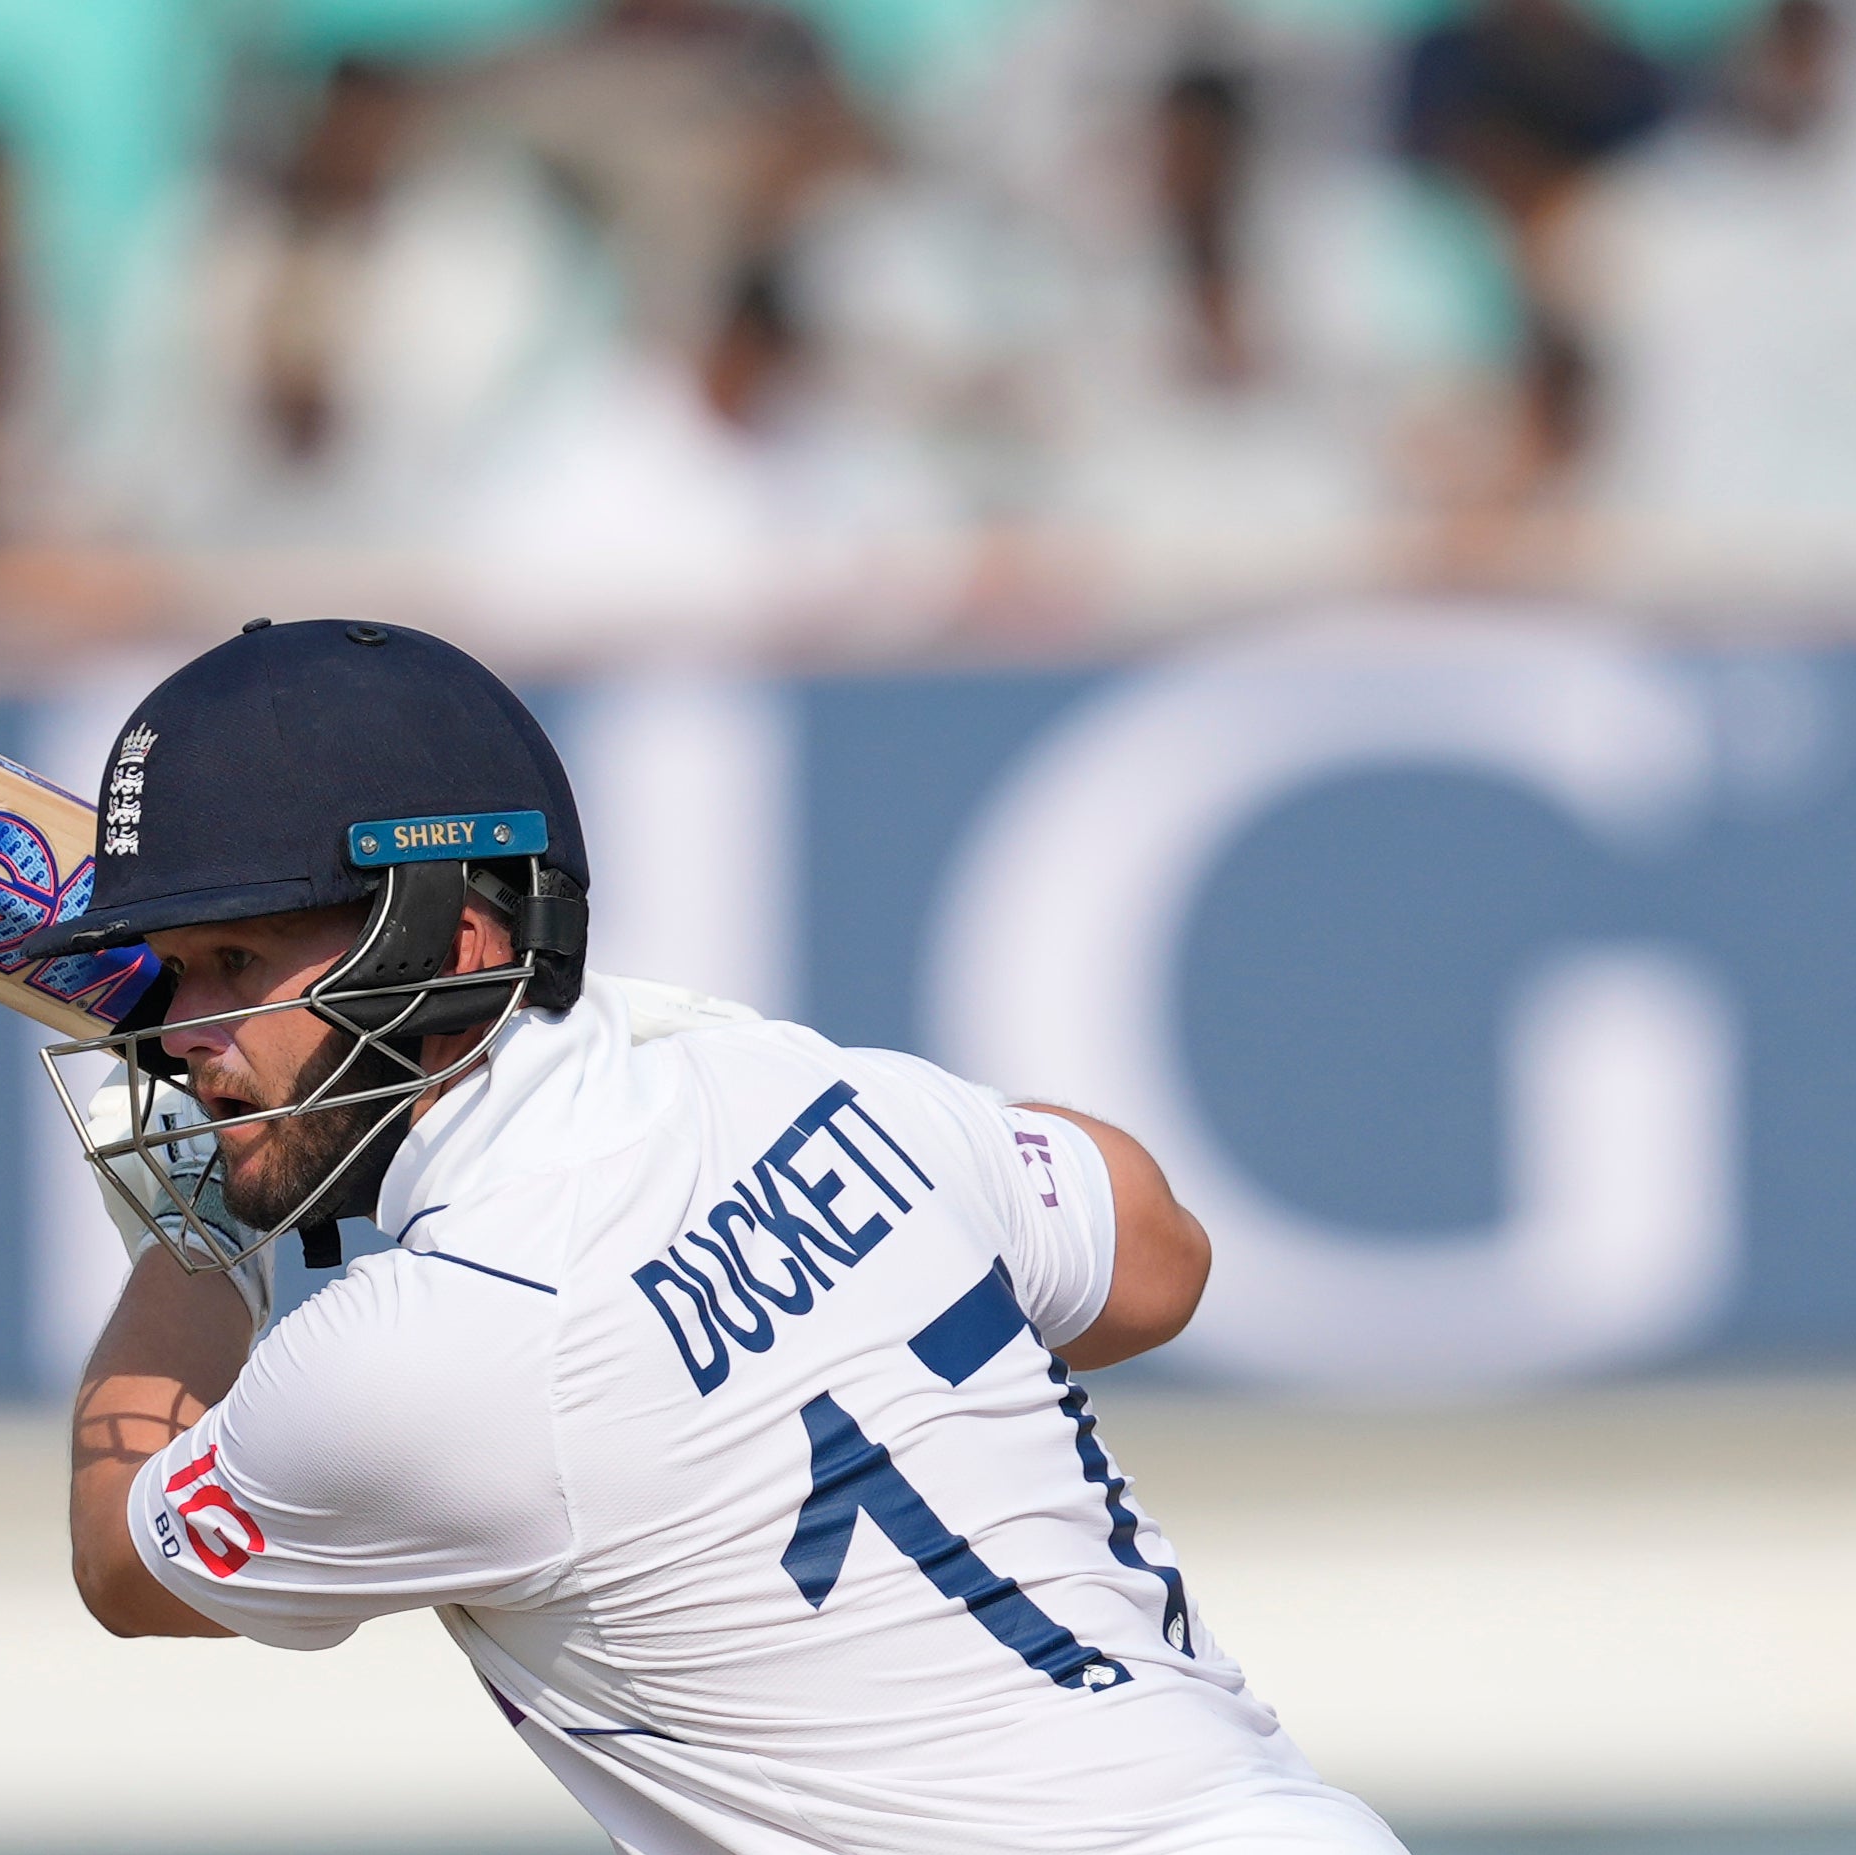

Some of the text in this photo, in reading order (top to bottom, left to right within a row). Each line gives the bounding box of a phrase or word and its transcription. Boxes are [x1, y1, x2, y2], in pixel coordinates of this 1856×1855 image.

[393, 820, 476, 850] SHREY
[631, 1079, 935, 1398] DUCKETT
[154, 1510, 181, 1560] BD
[780, 1254, 1197, 1693] 17
